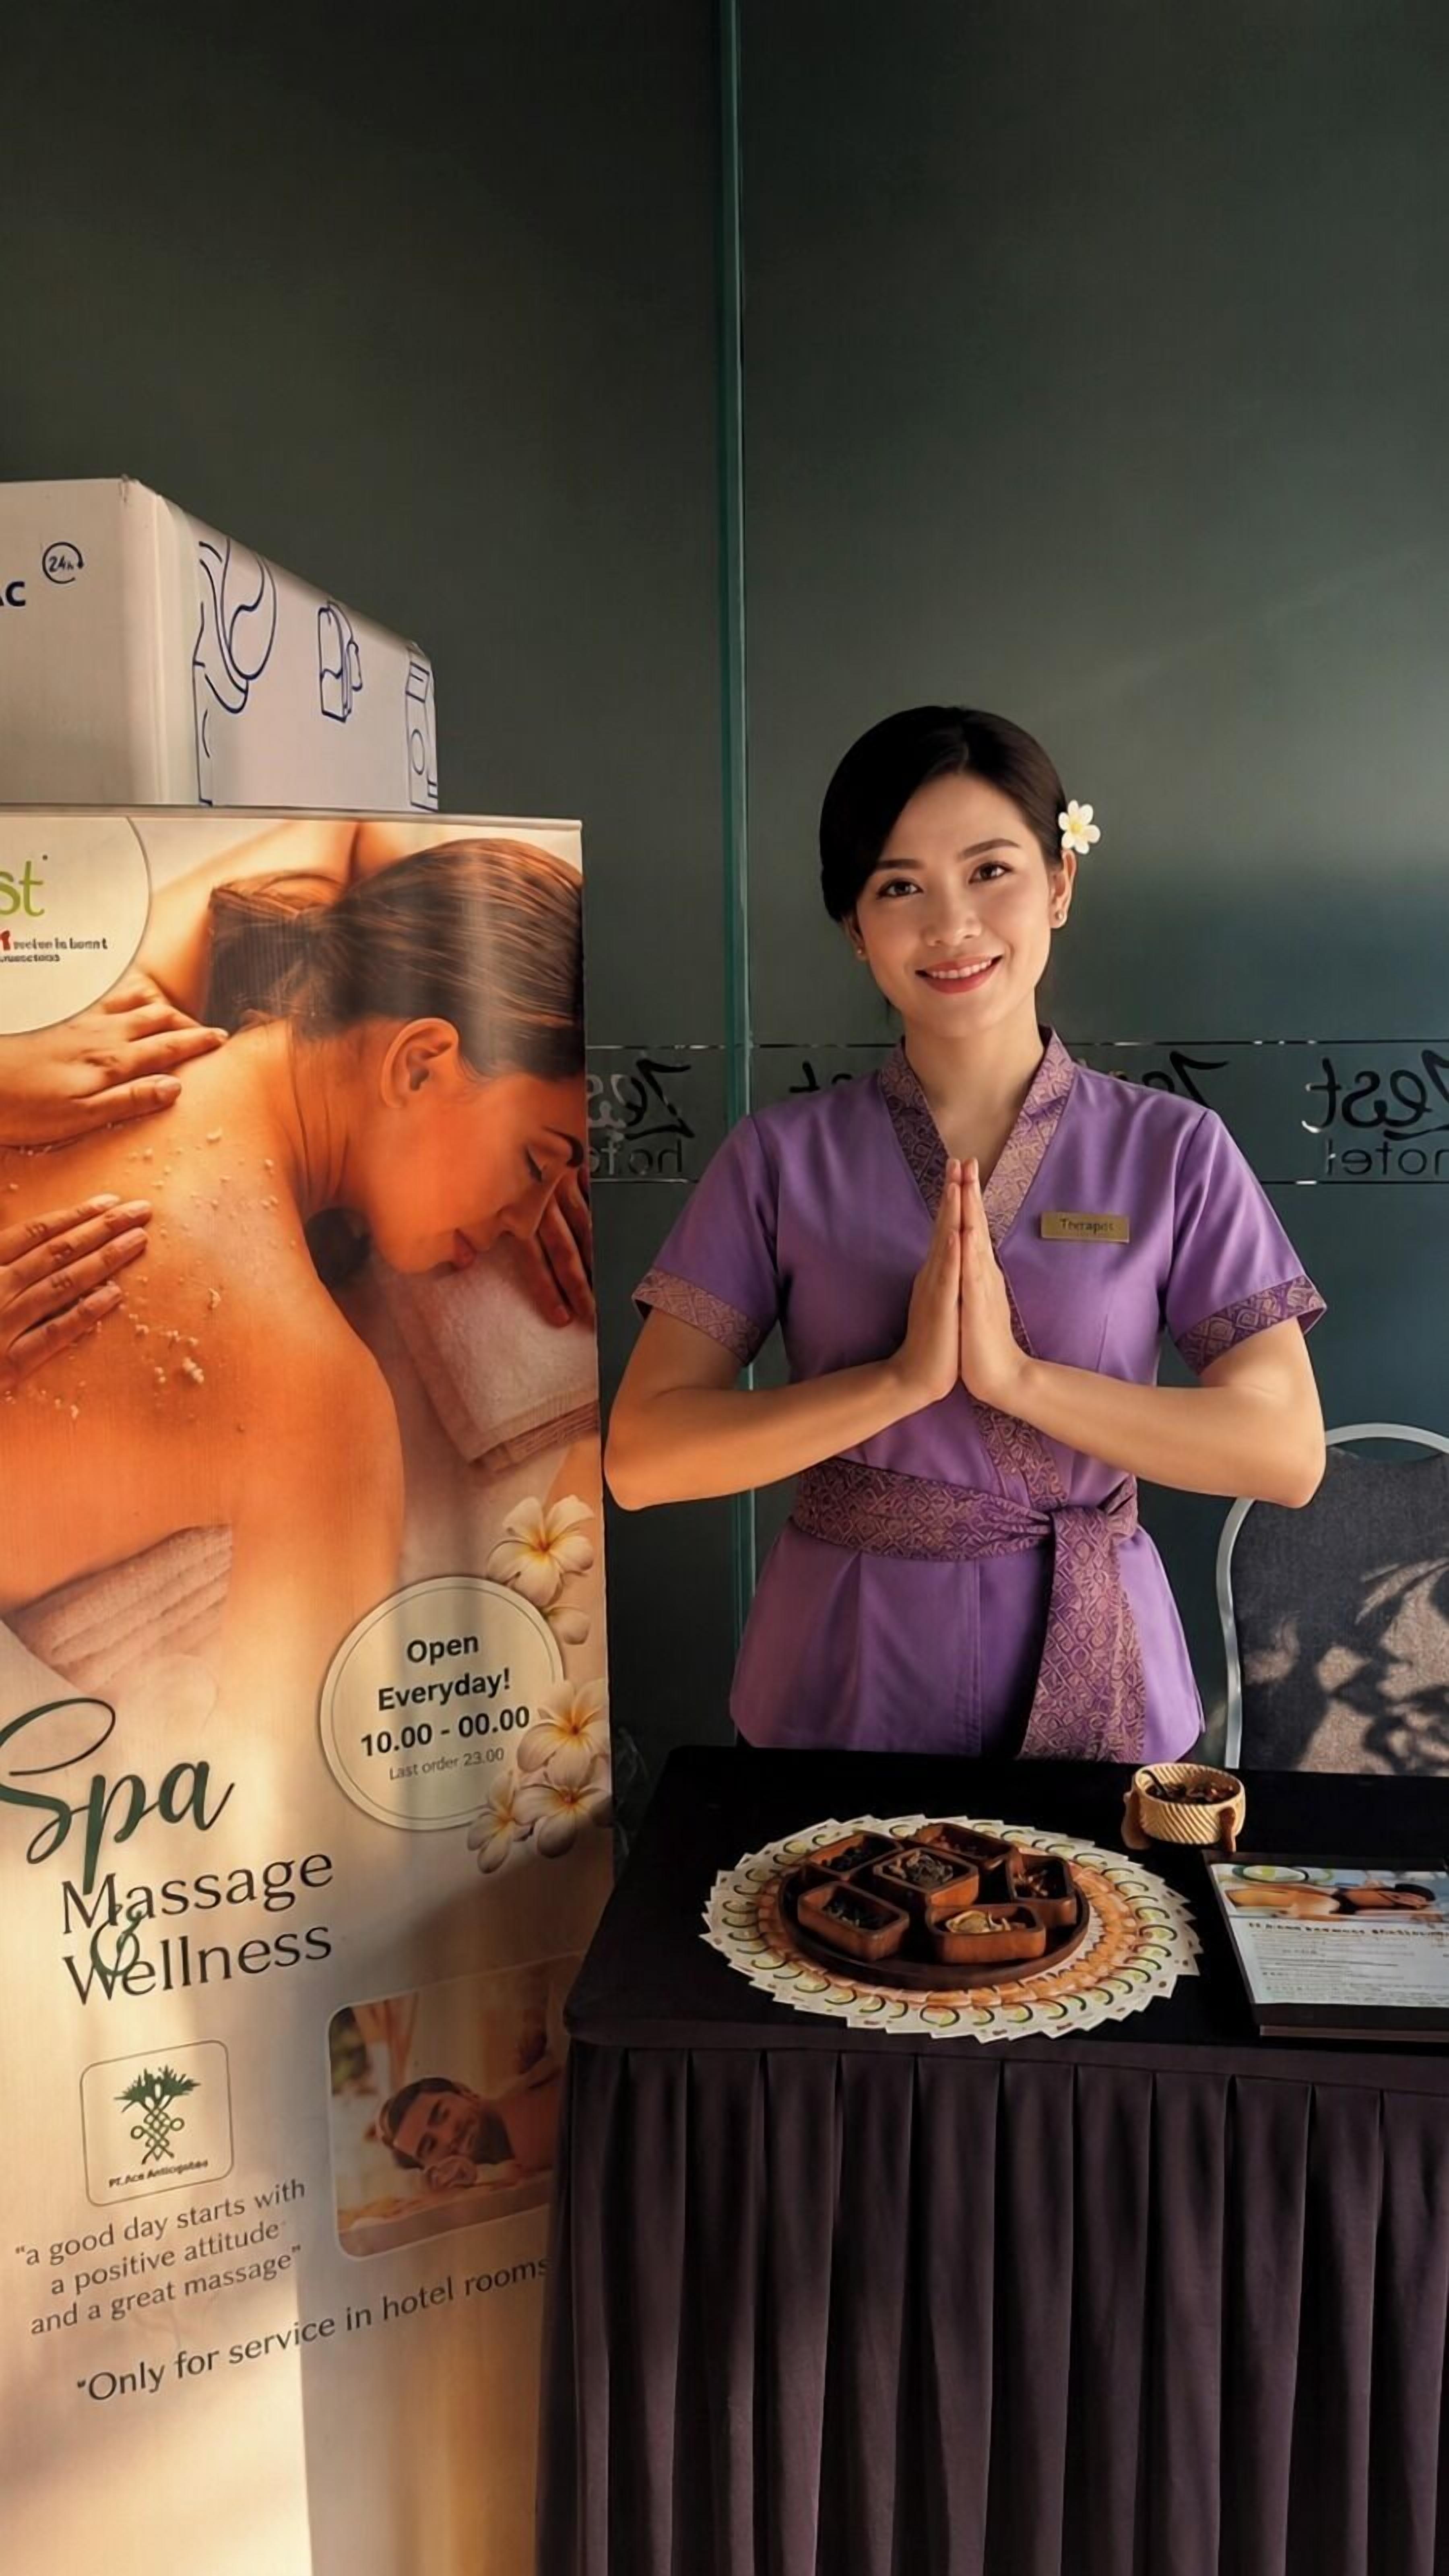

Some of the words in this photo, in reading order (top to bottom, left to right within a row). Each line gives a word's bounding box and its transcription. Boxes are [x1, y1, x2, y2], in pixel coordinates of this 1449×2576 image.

[0, 581, 26, 607] C
[0, 861, 45, 918] st
[407, 1635, 479, 1665] Open
[378, 1667, 510, 1711] Everyday!
[361, 1723, 432, 1757] 10.00
[458, 1706, 530, 1738] 00.00
[389, 1764, 418, 1780] Last
[421, 1756, 458, 1773] order
[463, 1746, 504, 1767] 23.00
[0, 1698, 235, 1895] Spa
[62, 1853, 334, 1934] Massage
[62, 1926, 332, 2006] Wellness
[50, 2222, 114, 2266] good
[124, 2215, 168, 2241] day
[177, 2197, 245, 2229] starts
[254, 2178, 305, 2209] with
[51, 2279, 64, 2295] a
[74, 2250, 175, 2295] positive
[31, 2301, 78, 2335] and
[87, 2304, 101, 2320] a
[111, 2280, 176, 2321] great
[173, 2350, 220, 2379] for
[228, 2317, 336, 2364] service
[346, 2306, 372, 2331] in
[383, 2275, 454, 2321] hotel
[464, 2257, 549, 2296] rooms
